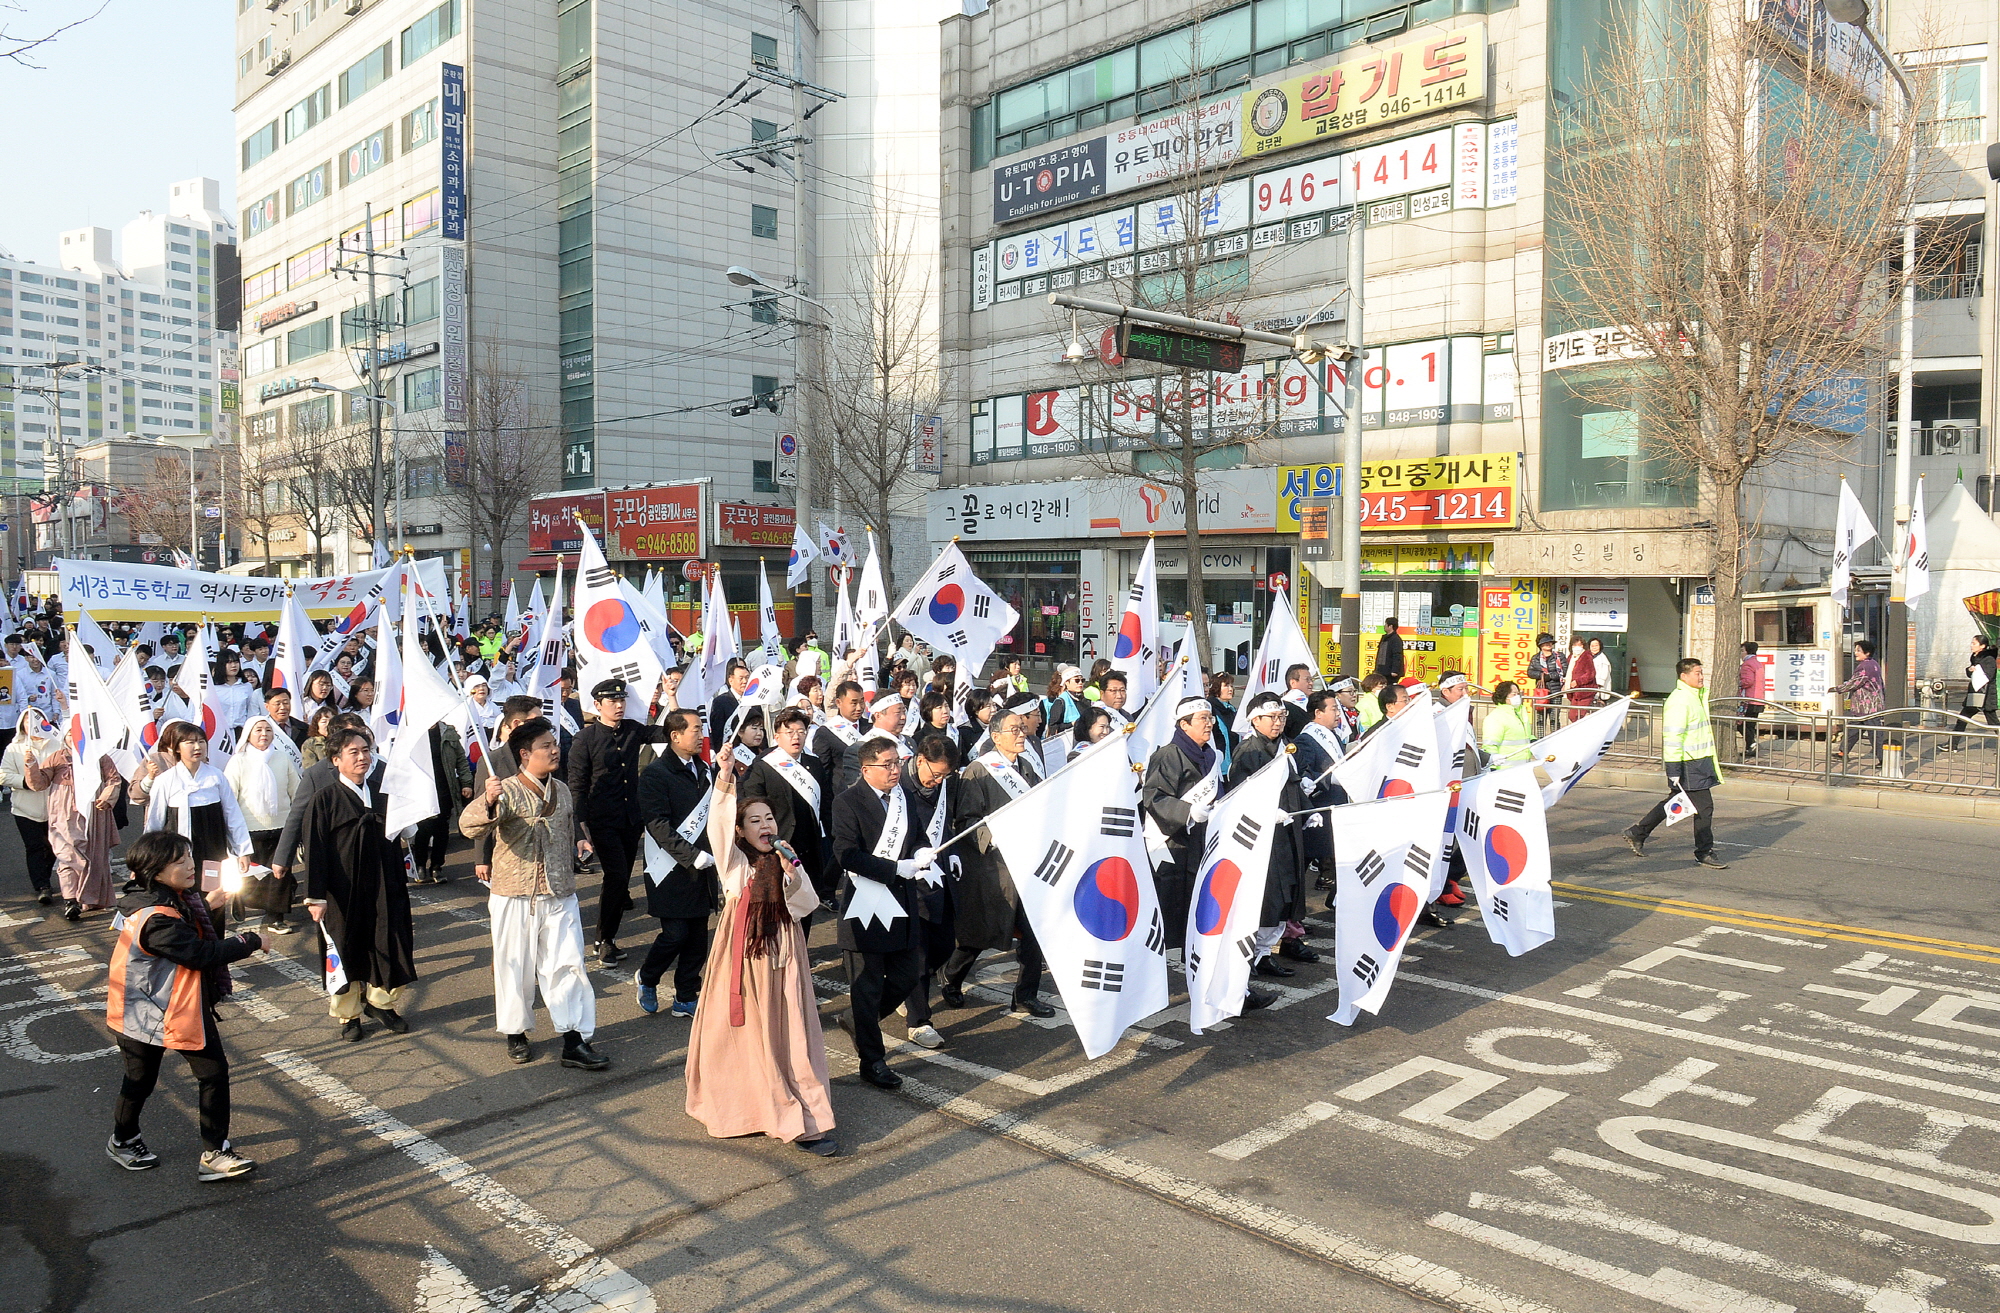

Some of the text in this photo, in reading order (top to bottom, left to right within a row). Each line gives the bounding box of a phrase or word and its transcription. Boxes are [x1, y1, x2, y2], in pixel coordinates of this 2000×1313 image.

[1300, 34, 1468, 122] 합기도
[443, 82, 463, 135] 내과
[1315, 109, 1367, 136] 교육상담
[1380, 82, 1466, 119] 946-1414
[1114, 120, 1234, 174] 유토피아학원
[1256, 135, 1282, 152] 검무관
[1004, 144, 1089, 178] 유토피아 초.중.고 영어
[1258, 142, 1438, 212] 946-1414
[1090, 184, 1100, 197] 4F
[1412, 192, 1450, 213] 인성교육
[1009, 190, 1080, 217] English for junior
[1372, 202, 1404, 222] 유아체육
[1254, 227, 1286, 246] 스트레칭
[1292, 219, 1322, 239] 줄넘기
[1024, 226, 1096, 268] 합기도
[1216, 237, 1245, 256] 무기술
[977, 253, 989, 305] 러시아삼보
[999, 282, 1019, 298] 러시아
[1181, 338, 1212, 364] 단속
[1548, 337, 1585, 363] 합기도
[223, 390, 236, 409] 치과
[1112, 373, 1308, 422] Speaking
[1388, 406, 1445, 423] 948-1905
[1493, 405, 1511, 417] 영어
[1279, 419, 1319, 432] 영어·중국어
[922, 426, 935, 465] 부동산
[1031, 442, 1076, 455] 948-1905
[566, 450, 591, 475] 치과
[1498, 456, 1510, 482] 사무소
[613, 496, 698, 529] 굿모닝 공인중개사 사무소
[725, 506, 759, 526] 굿모닝
[1360, 491, 1506, 523] 945-1214
[531, 508, 551, 534] 부어
[647, 531, 697, 555] 946-8588
[1542, 543, 1646, 562] 시온빌딩
[1152, 553, 1242, 568] nycall CYON
[68, 574, 193, 602] 세경고등학교
[1082, 581, 1099, 660] alleh kt
[1789, 653, 1825, 667] 광택
[1789, 668, 1825, 682] 수선
